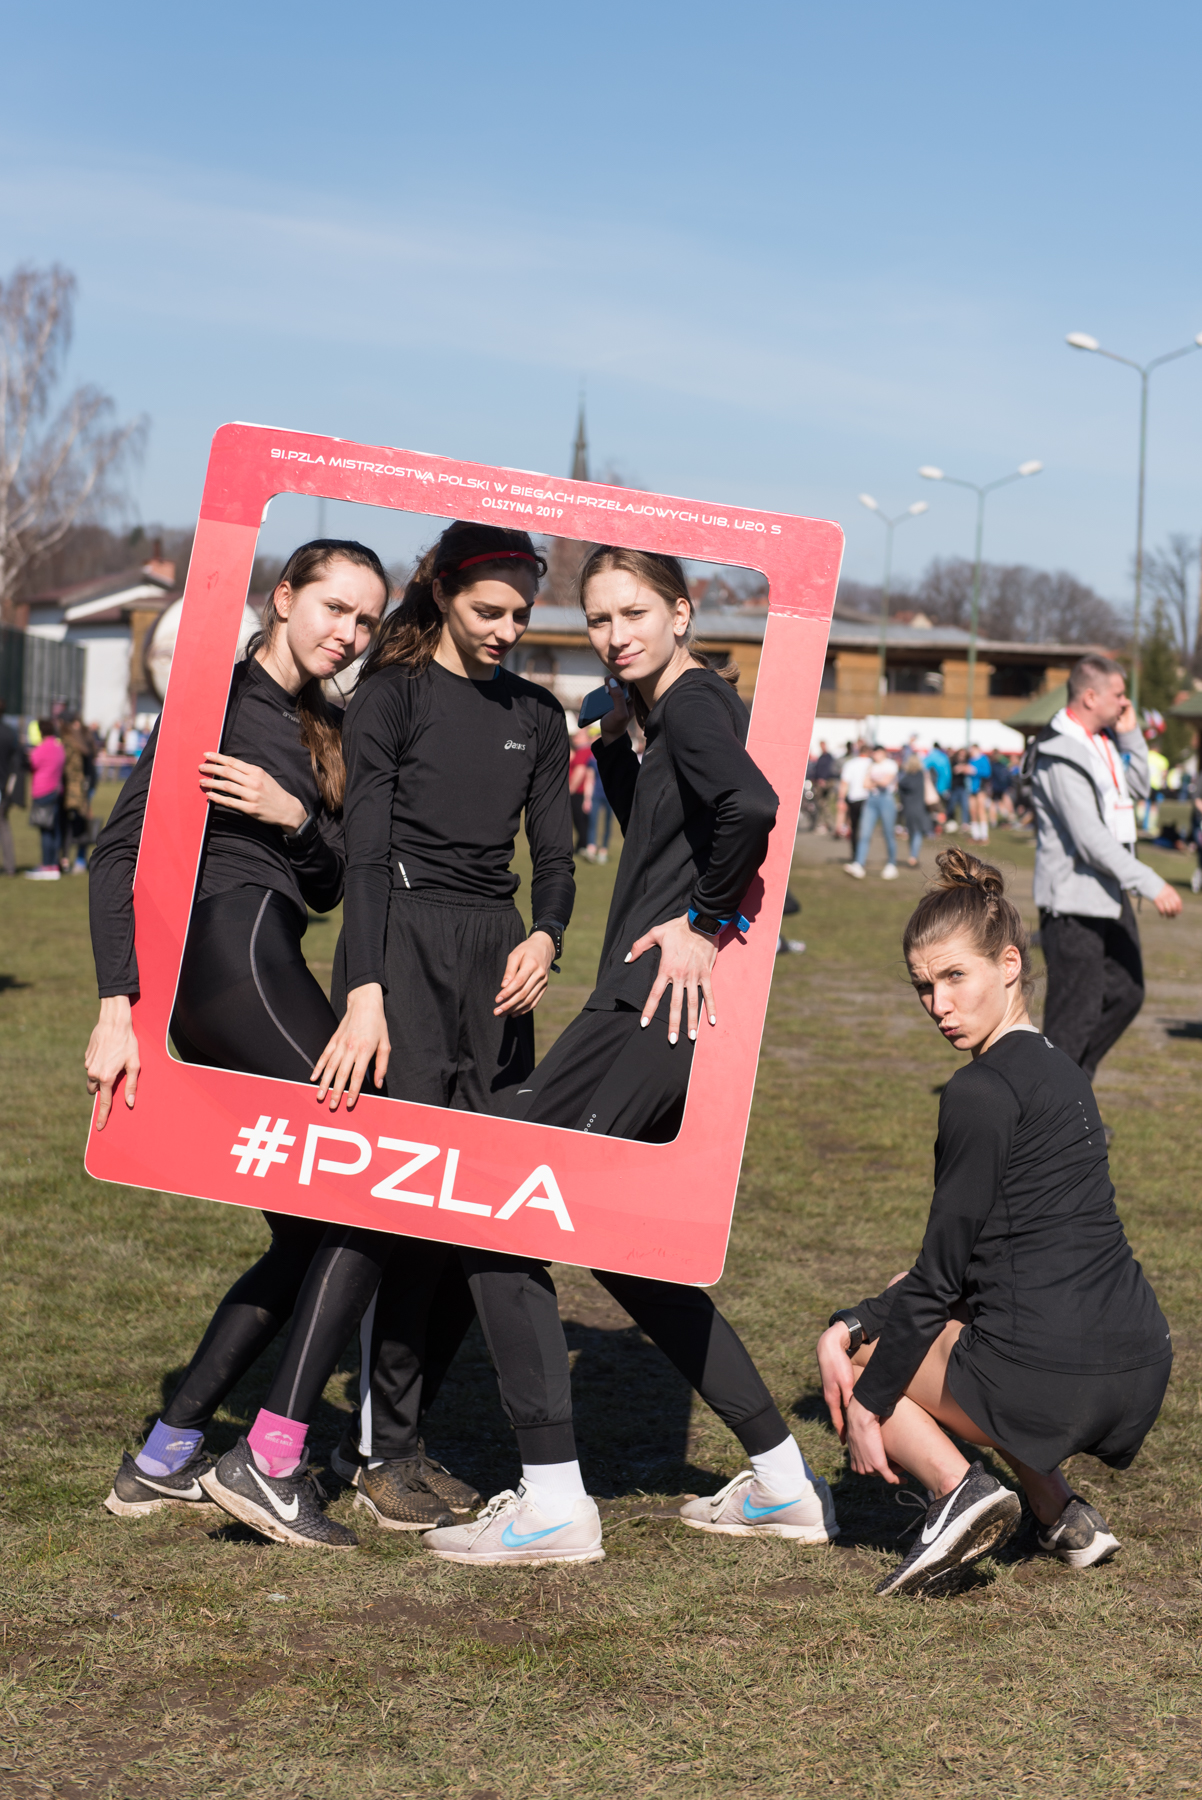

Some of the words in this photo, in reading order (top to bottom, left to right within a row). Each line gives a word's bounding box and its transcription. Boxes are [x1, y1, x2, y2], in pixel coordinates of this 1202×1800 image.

[328, 456, 435, 482] MISTRZOSTWA
[438, 473, 490, 490] POLSKI
[493, 481, 509, 493] W
[510, 485, 575, 504] BIEGACH
[576, 495, 699, 523] PRZEŁAJOWYCH
[701, 514, 730, 528] U18,
[734, 519, 767, 534] U20,
[770, 524, 782, 535] S
[481, 497, 533, 515] OLSZYNA
[535, 505, 564, 519] 2019
[229, 1114, 576, 1233] #PZLA
